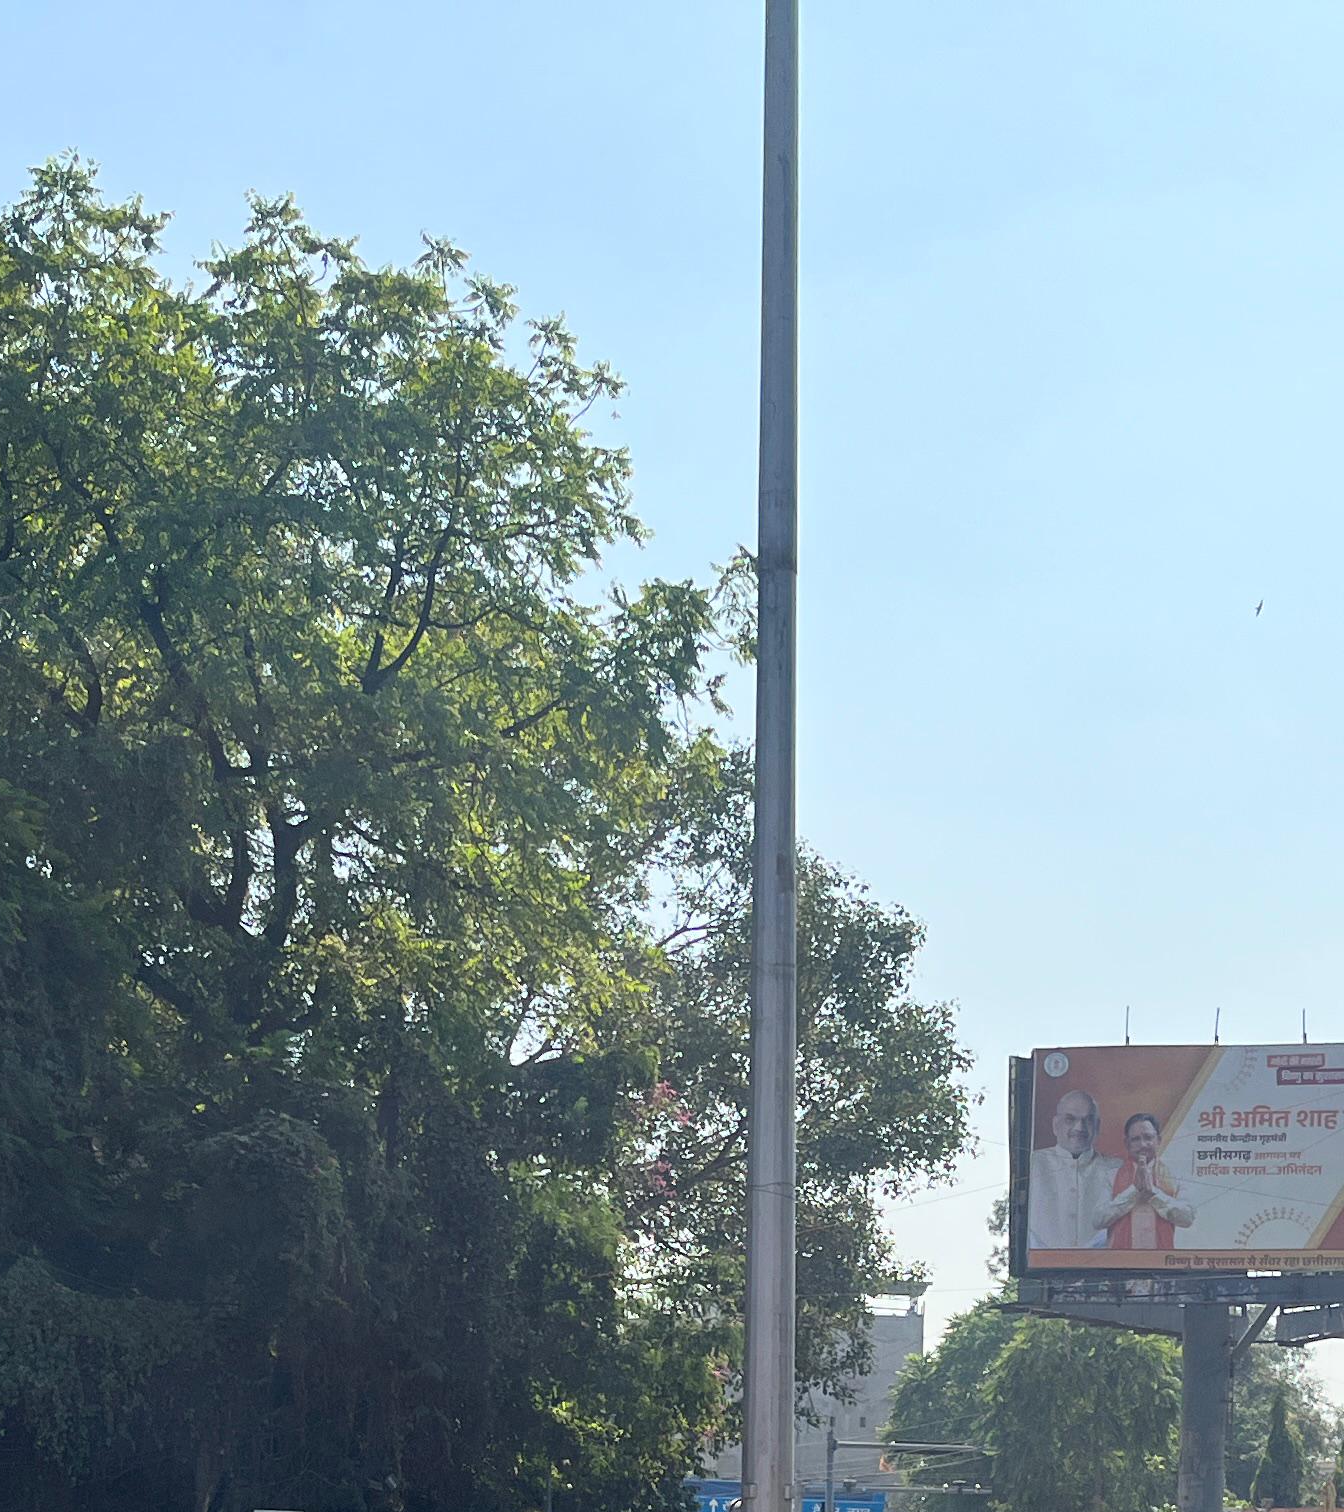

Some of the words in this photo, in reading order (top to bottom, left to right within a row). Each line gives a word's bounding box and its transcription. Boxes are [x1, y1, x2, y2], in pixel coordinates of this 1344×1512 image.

[1198, 1105, 1225, 1129] श्री
[1230, 1105, 1291, 1128] अमित
[1296, 1109, 1339, 1130] शाह
[1197, 1146, 1252, 1163] छत्तीसगढ़
[1193, 1255, 1204, 1266] के
